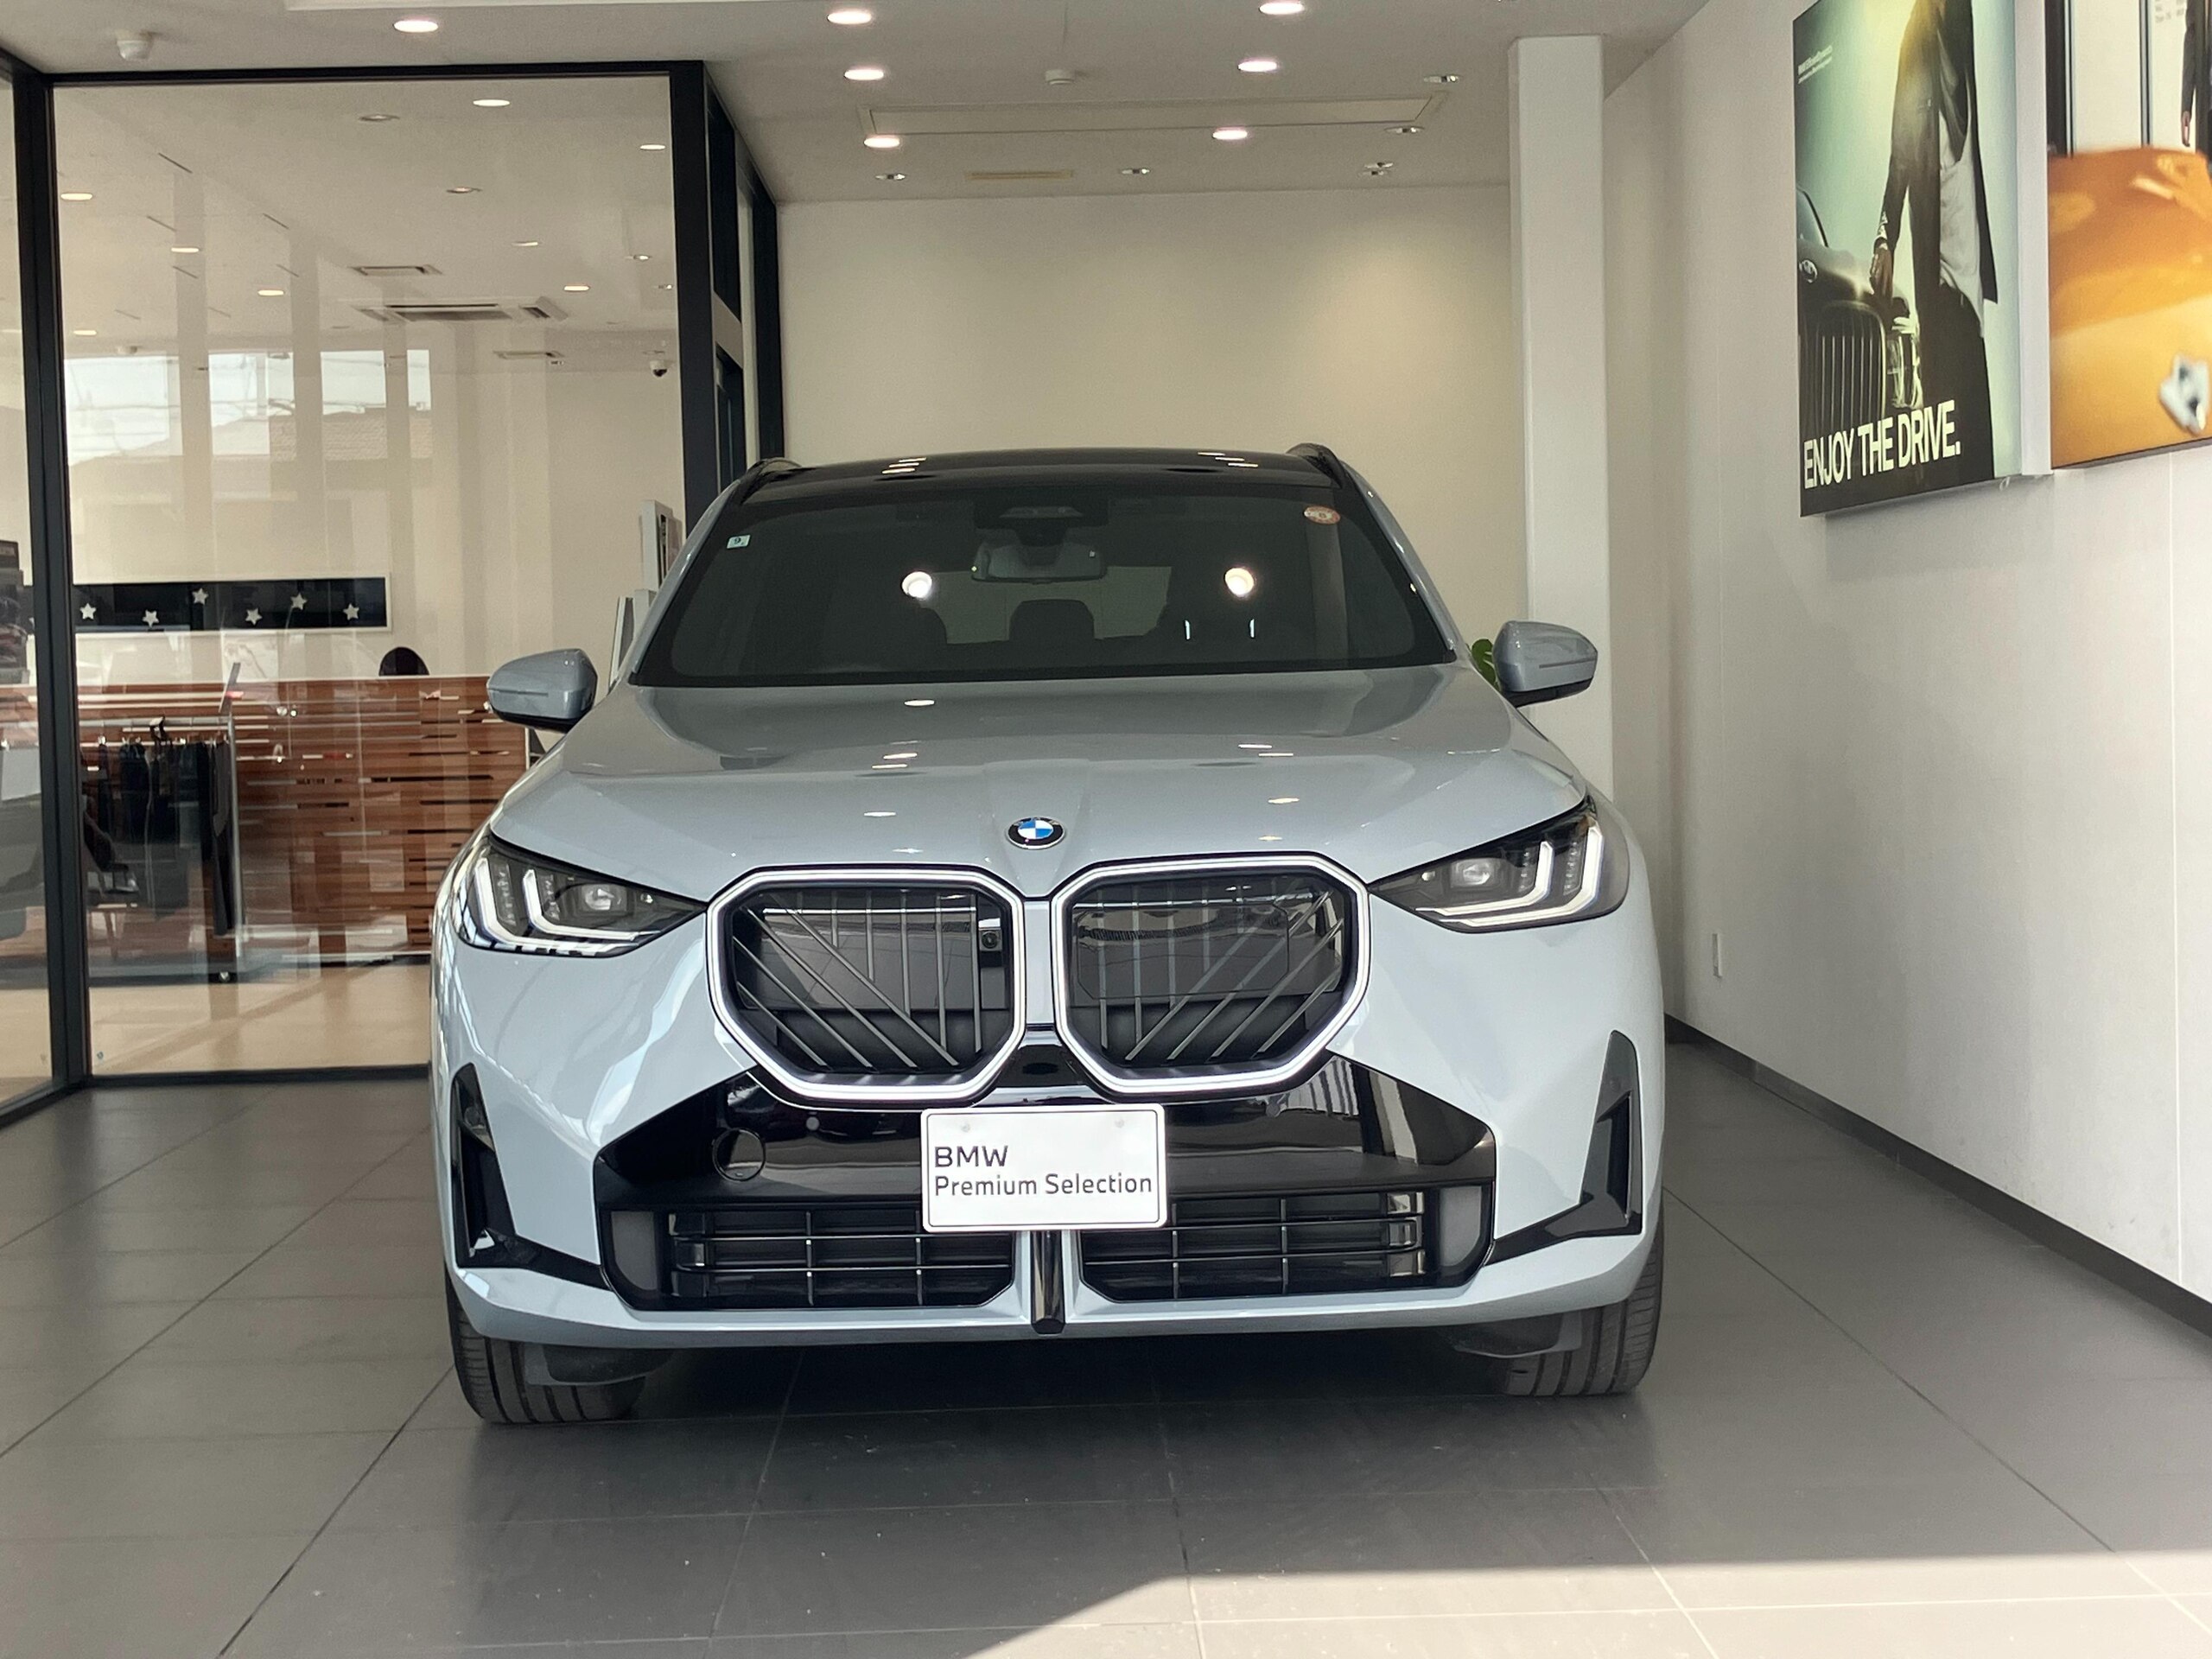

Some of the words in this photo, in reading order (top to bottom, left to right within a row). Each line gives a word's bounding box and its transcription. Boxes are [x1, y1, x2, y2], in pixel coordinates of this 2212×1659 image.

[1804, 428, 1854, 489] ENJOY
[1858, 416, 1894, 476] THE
[1897, 399, 1961, 467] DRIVE.
[934, 1146, 1008, 1167] BMW
[935, 1174, 1037, 1196] Premium
[1045, 1173, 1152, 1194] Selection
